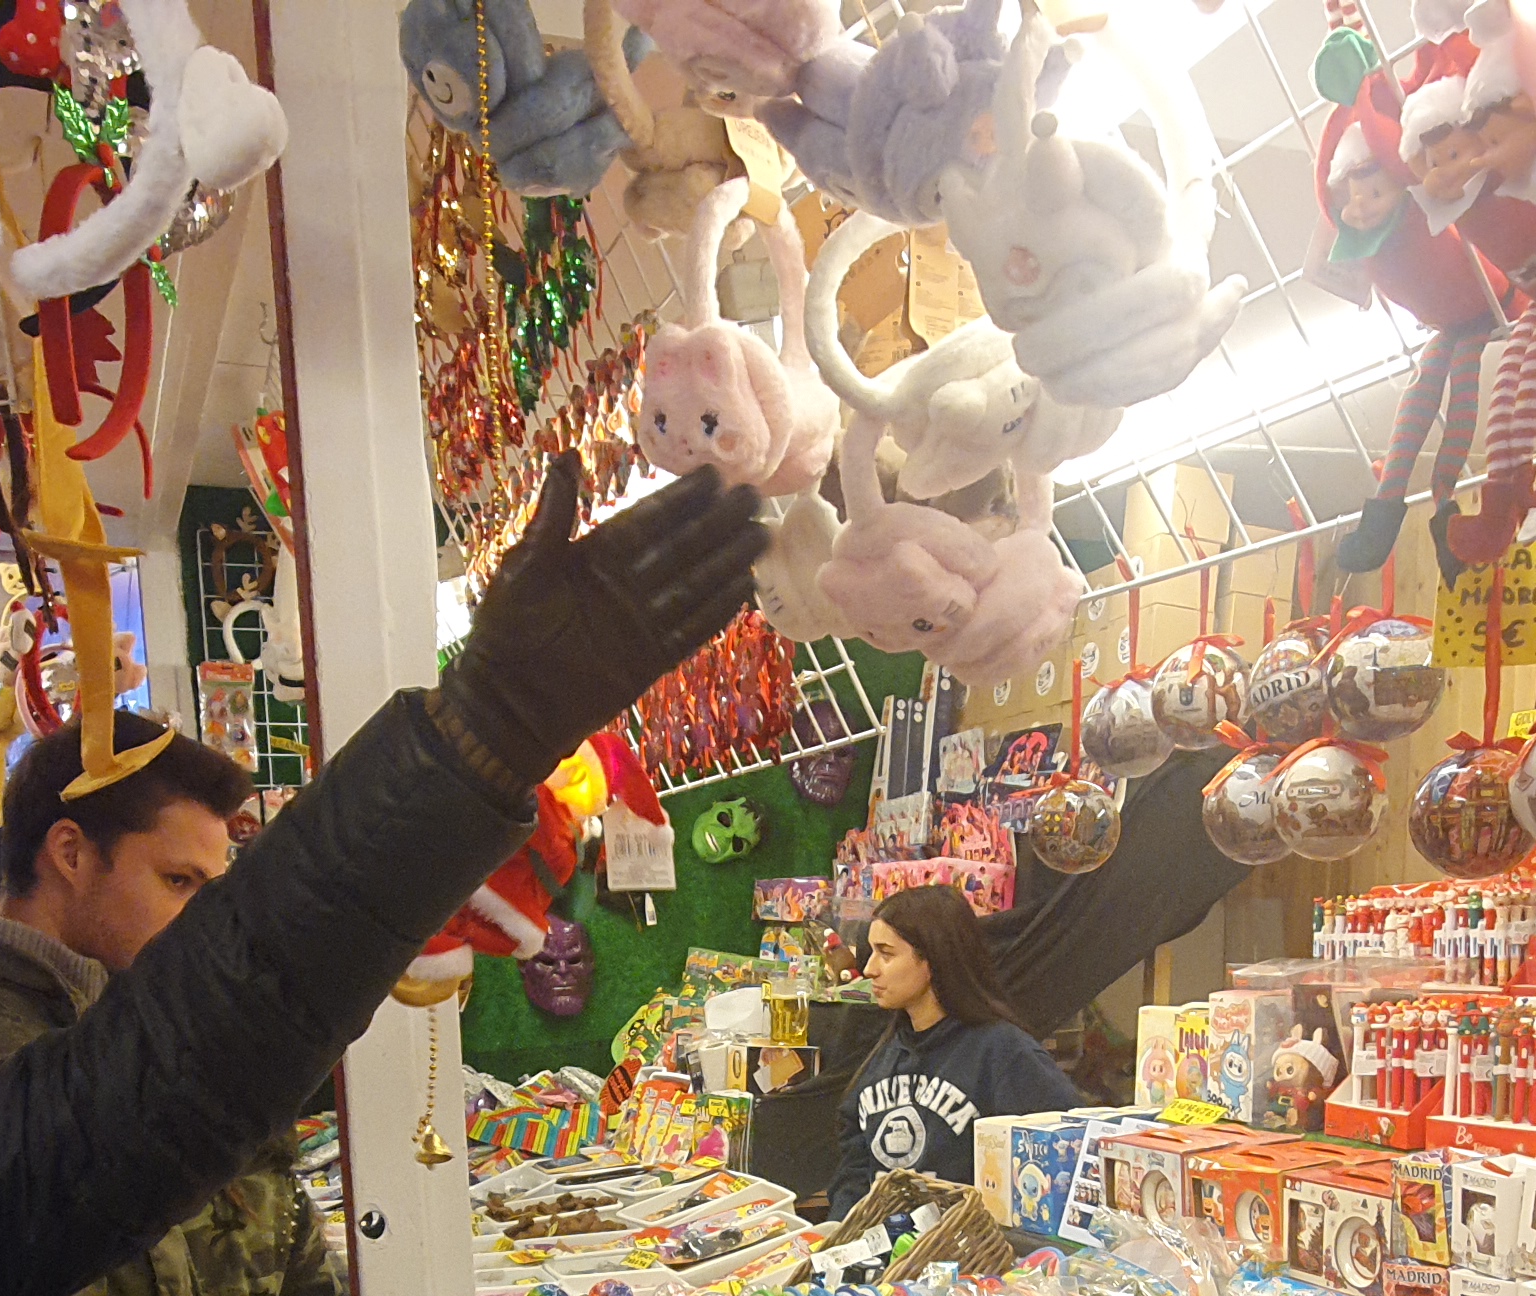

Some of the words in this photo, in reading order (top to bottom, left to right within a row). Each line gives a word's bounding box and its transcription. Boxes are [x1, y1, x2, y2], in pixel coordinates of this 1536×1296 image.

[1249, 667, 1313, 706] ADRID
[1455, 1125, 1474, 1146] Be
[1393, 1161, 1444, 1182] MADRID
[1384, 1266, 1443, 1286] MADRID
